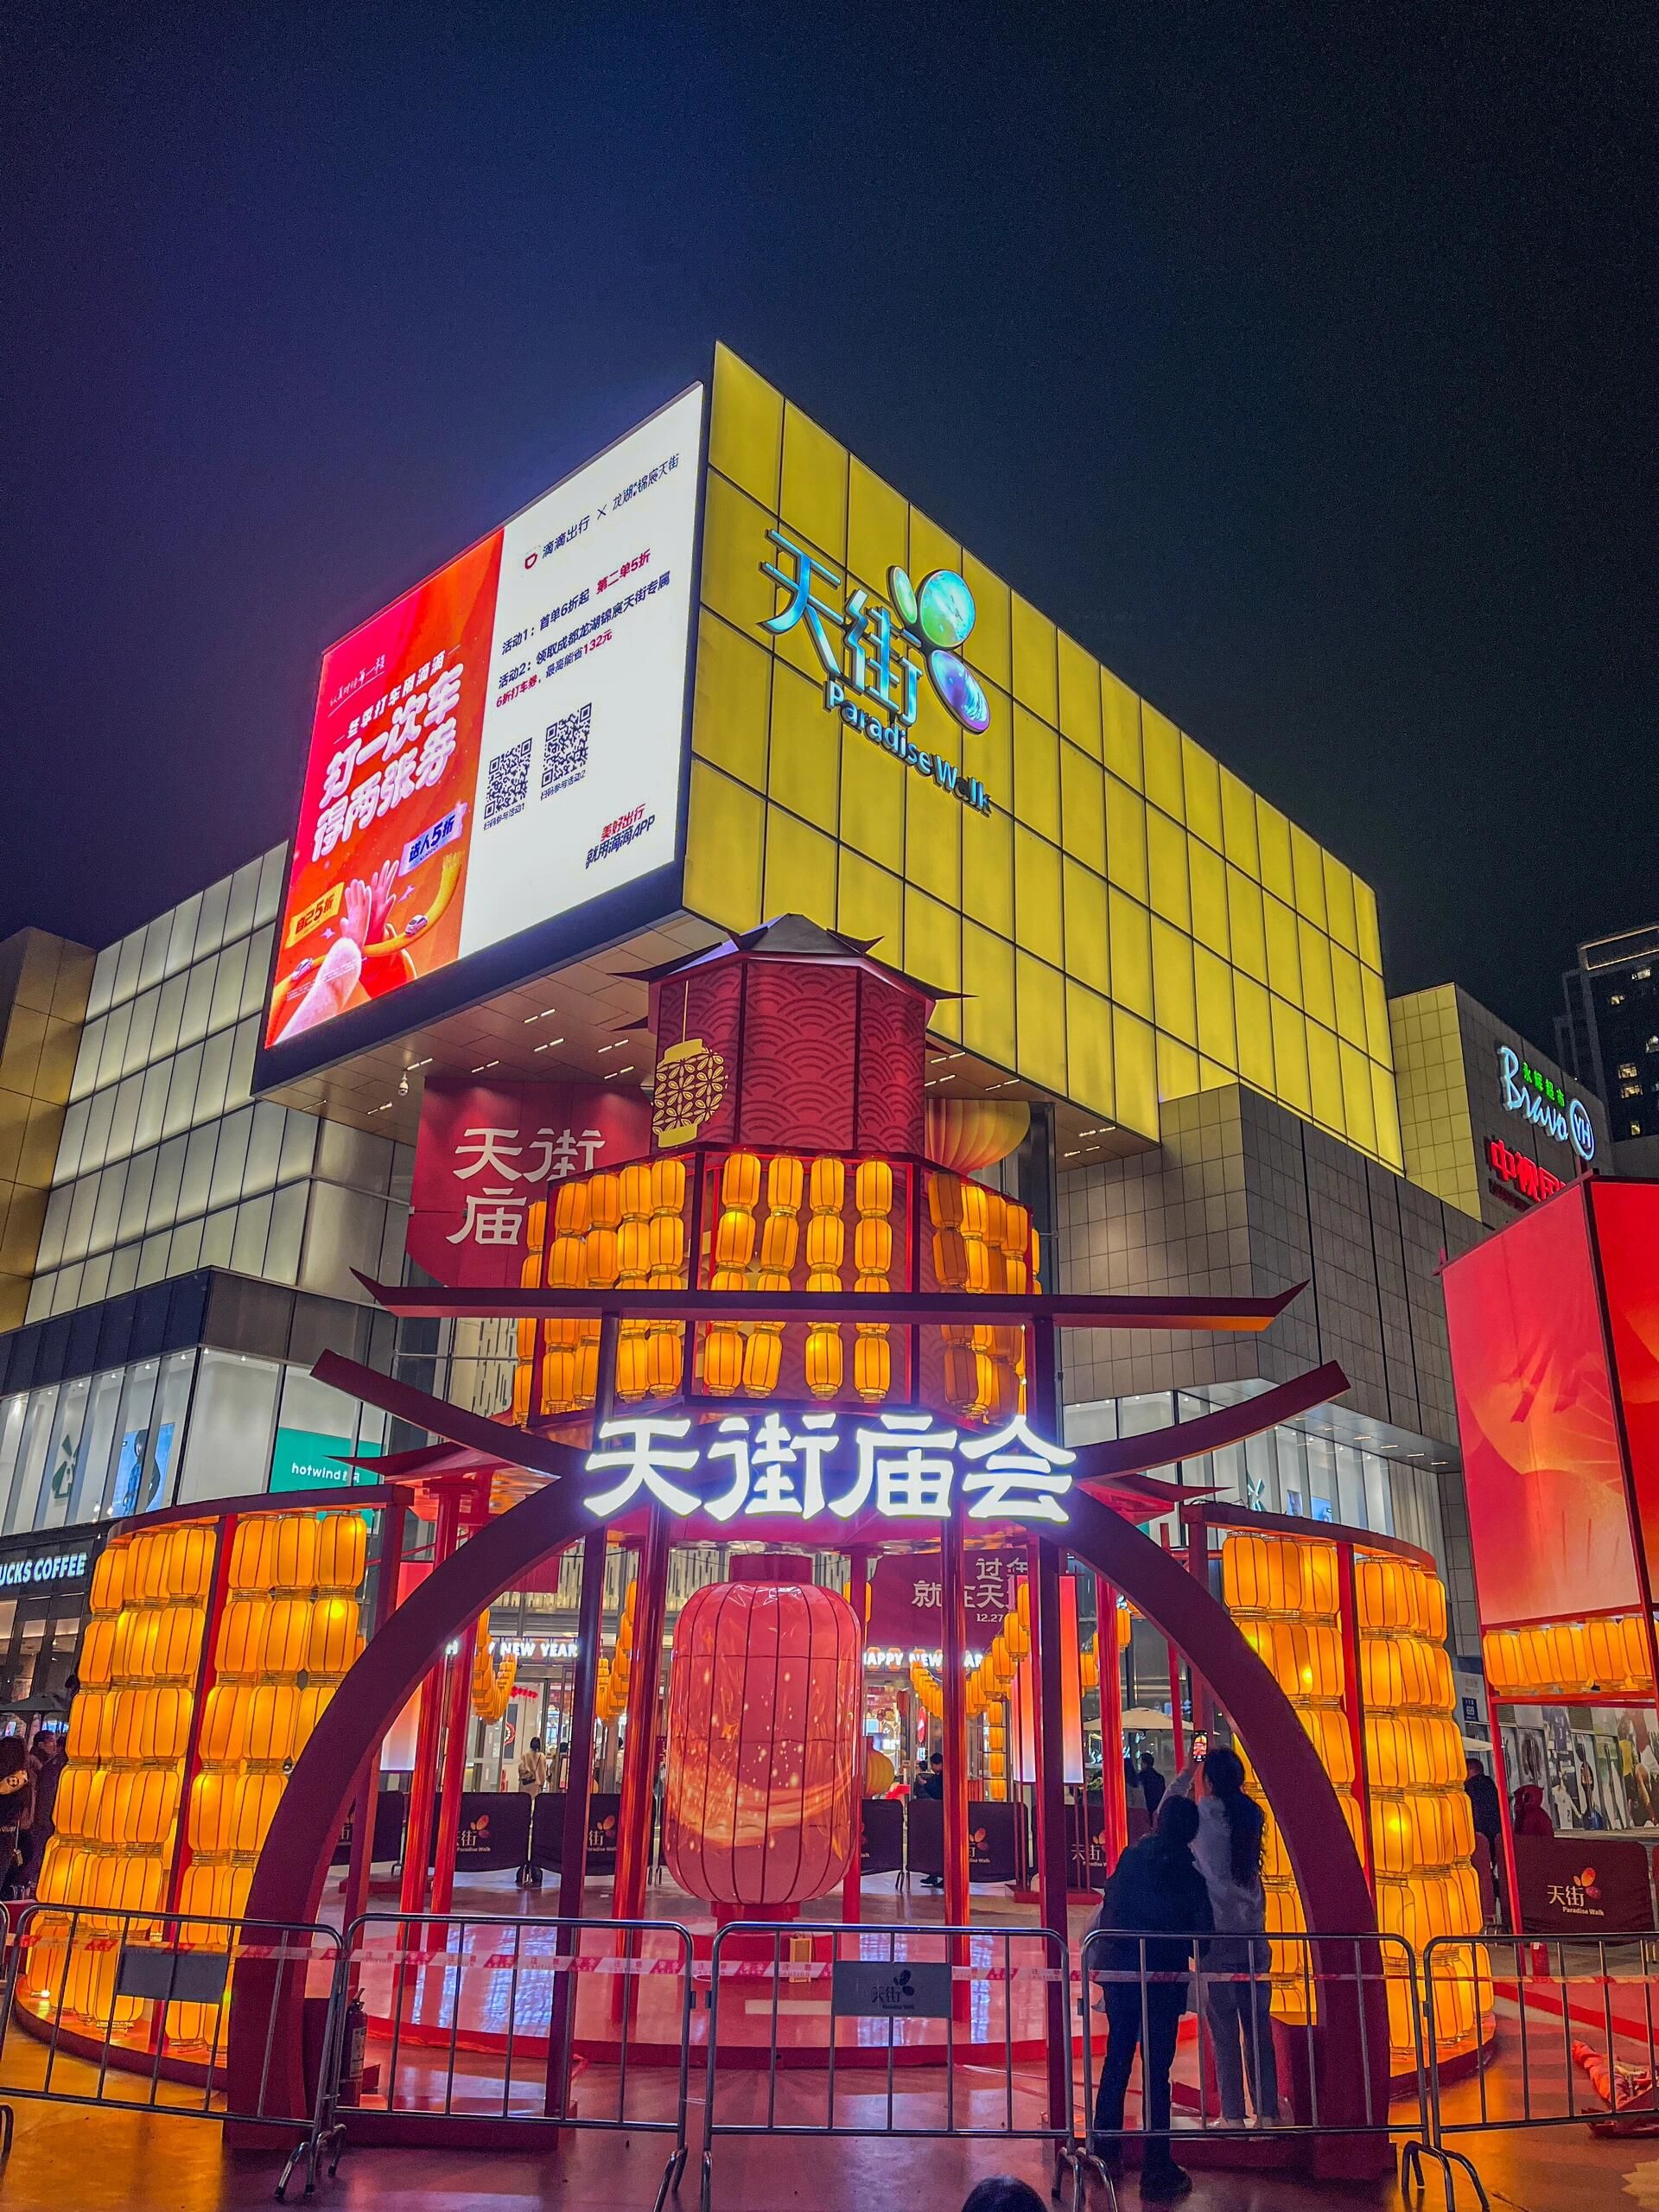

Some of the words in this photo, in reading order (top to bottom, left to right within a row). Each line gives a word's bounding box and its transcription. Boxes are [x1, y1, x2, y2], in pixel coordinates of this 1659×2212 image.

[542, 515, 590, 559] 滴滴出行
[596, 549, 651, 594] 第二单5折
[757, 528, 924, 728] 天街
[319, 663, 464, 809] 打一次车
[823, 679, 932, 777] Paradise
[312, 716, 457, 862] 得两张券
[601, 803, 646, 842] 美好出行
[1497, 1046, 1569, 1141] Bravo
[452, 1128, 606, 1183] 天街
[446, 1187, 527, 1245] 庙
[291, 1462, 341, 1480] hotwind
[583, 1413, 1077, 1522] 天街庙会
[34, 1552, 86, 1582] COFFEE
[499, 1642, 536, 1657] NEW
[540, 1643, 579, 1657] YEAR
[1547, 1885, 1585, 1908] 天街
[1562, 1905, 1589, 1916] Paradise
[1589, 1908, 1605, 1916] Walk
